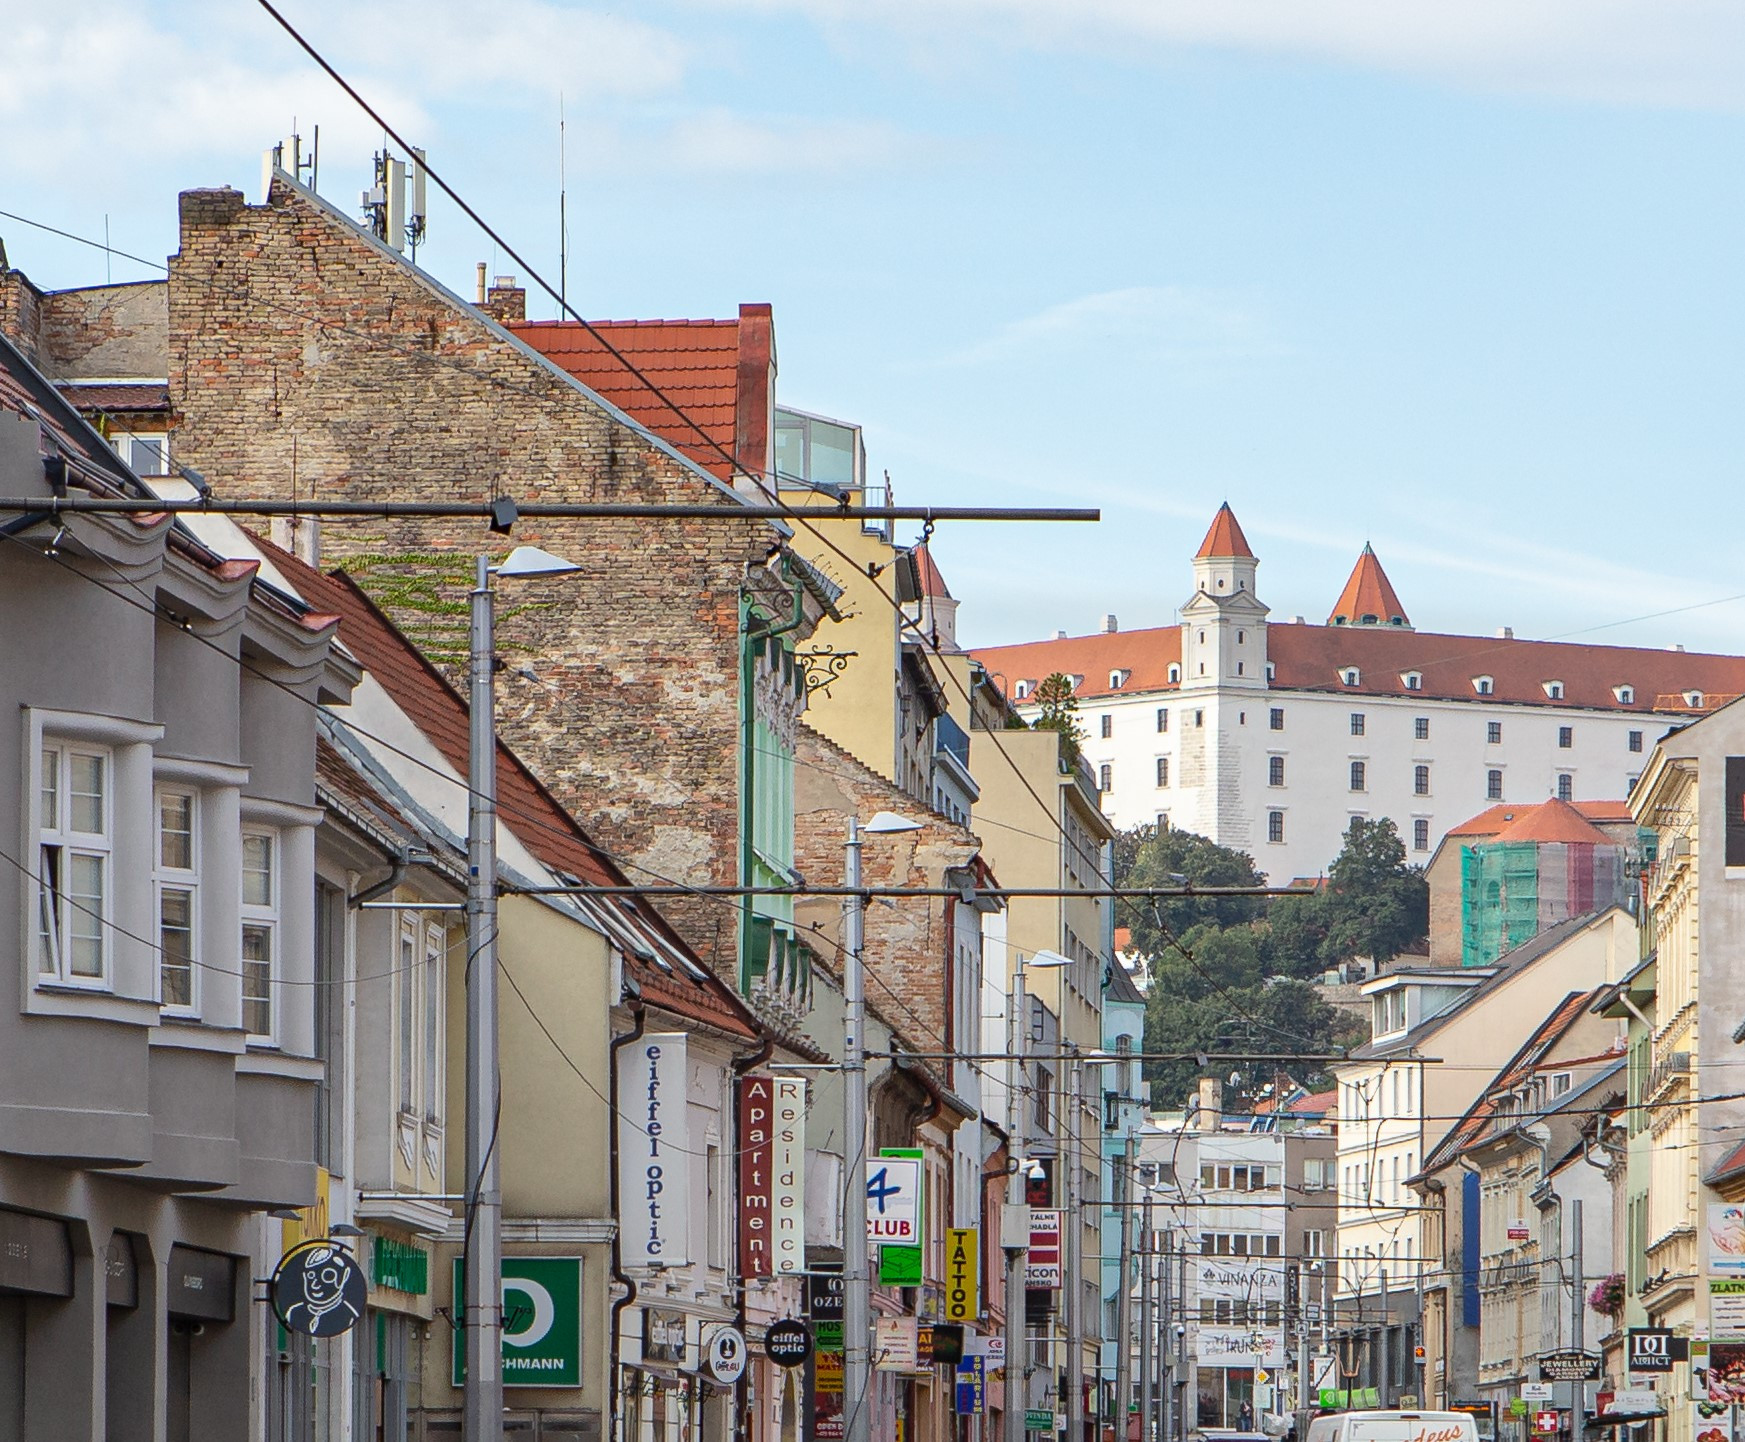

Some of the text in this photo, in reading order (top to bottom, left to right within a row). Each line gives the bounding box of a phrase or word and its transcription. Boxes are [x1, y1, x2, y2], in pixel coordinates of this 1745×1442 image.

[646, 1045, 664, 1255] eiffel optic
[745, 1082, 767, 1274] Apartment
[779, 1083, 797, 1271] Residence
[952, 1232, 966, 1318] TATTOO
[1218, 1272, 1277, 1287] VINANZA
[772, 1333, 804, 1343] eiffel
[772, 1343, 804, 1355] optic
[1540, 1360, 1599, 1368] JEWELLERY
